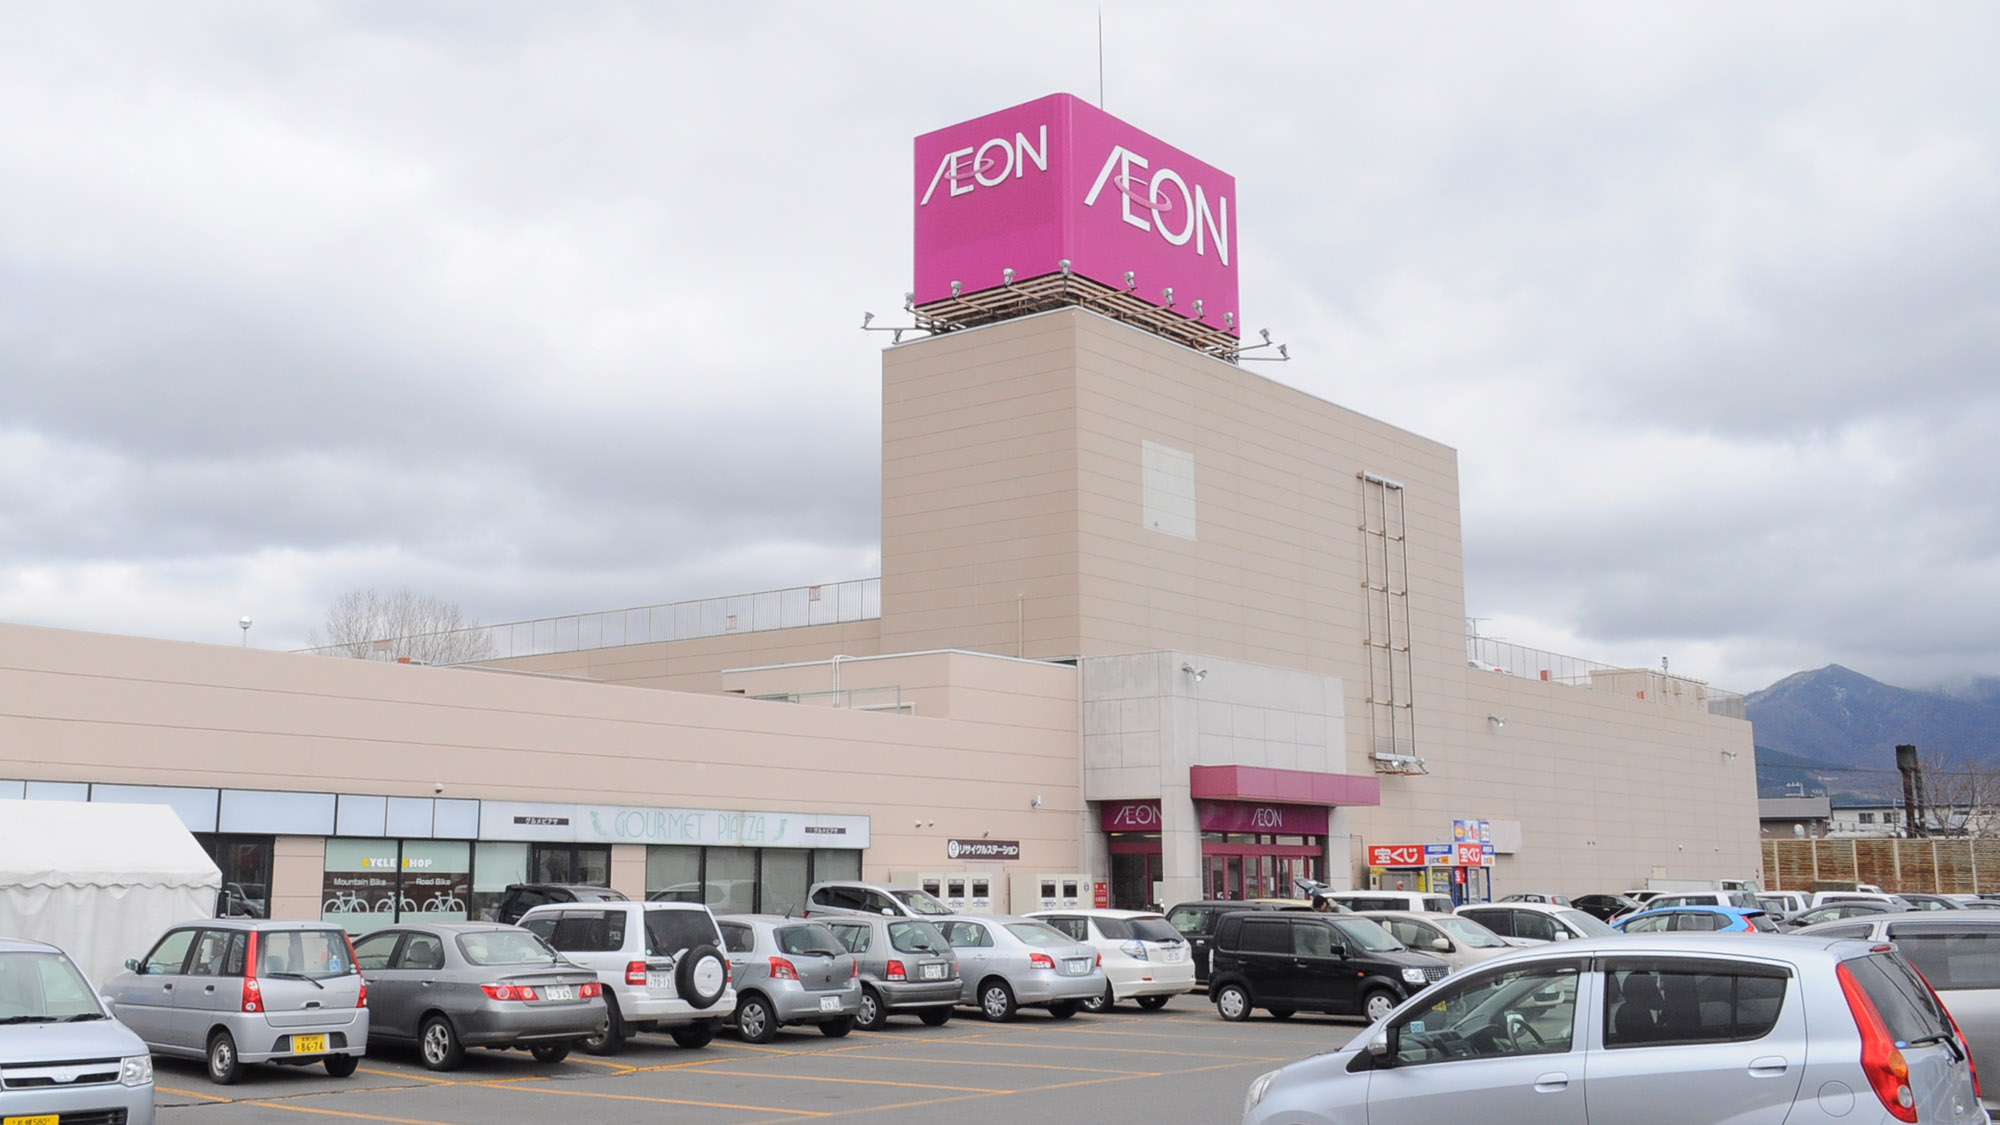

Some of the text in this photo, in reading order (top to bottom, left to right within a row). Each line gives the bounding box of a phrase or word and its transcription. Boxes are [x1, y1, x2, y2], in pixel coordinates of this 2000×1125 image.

[614, 810, 766, 842] GOURMET PIAZZA
[960, 844, 1018, 856] リサイクルステーション
[1374, 847, 1418, 864] 宝くじ
[1459, 847, 1481, 863] 宝くじ
[362, 857, 432, 868] CYCLE SHOP
[333, 877, 387, 886] Mountain Bike
[415, 877, 451, 886] Road Bike
